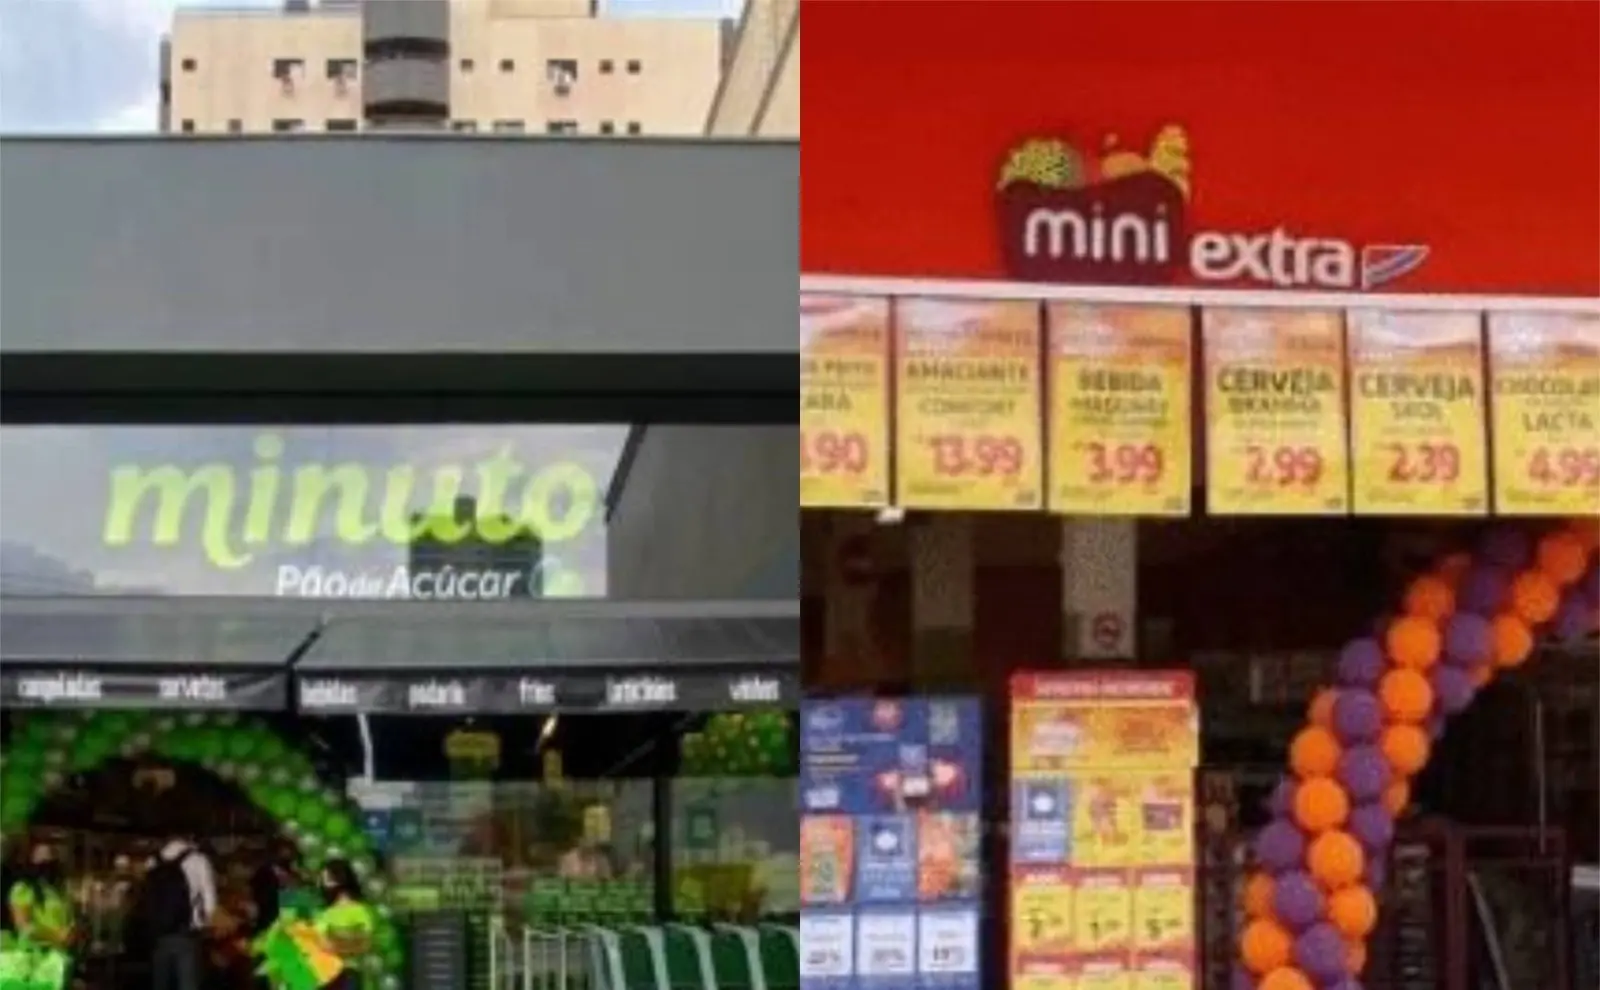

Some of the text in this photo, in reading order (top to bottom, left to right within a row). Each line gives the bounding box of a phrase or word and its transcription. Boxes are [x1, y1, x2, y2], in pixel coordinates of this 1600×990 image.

[1024, 204, 1355, 288] mini extra
[1216, 367, 1336, 395] CERVEJA
[1358, 373, 1475, 402] CERVEJA
[1521, 411, 1594, 432] LACTA
[104, 433, 598, 569] minuto
